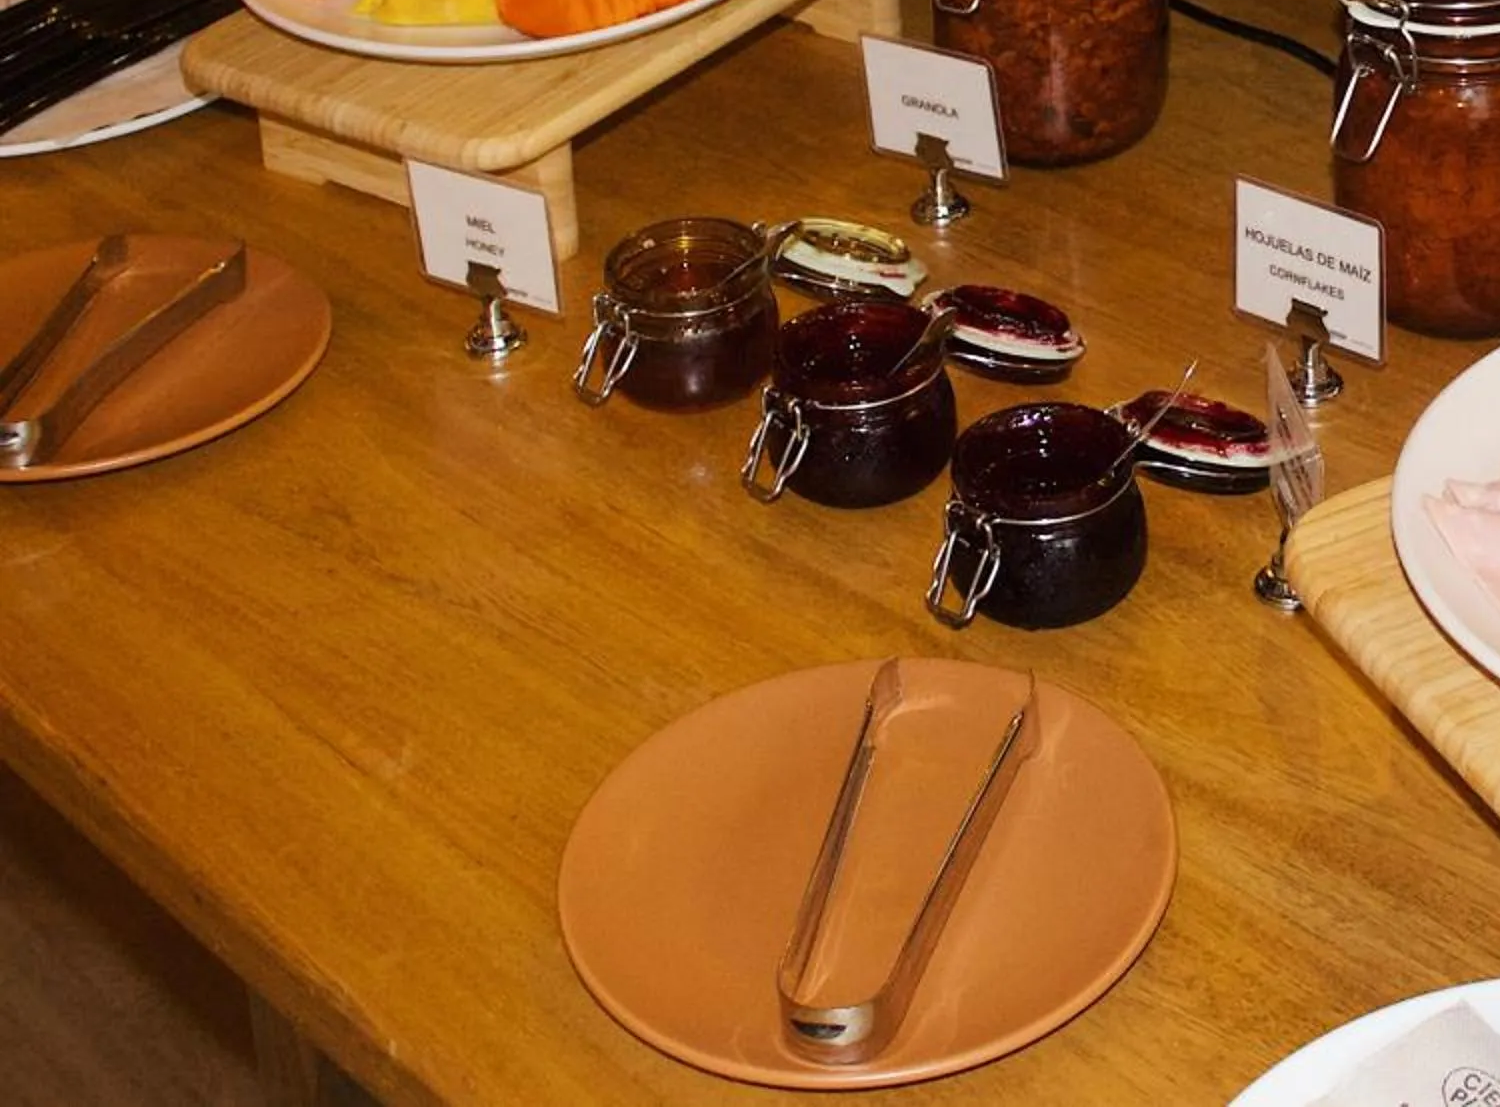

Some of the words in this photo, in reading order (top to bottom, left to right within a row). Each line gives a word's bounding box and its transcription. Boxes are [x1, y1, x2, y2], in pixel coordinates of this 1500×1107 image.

[901, 94, 960, 120] GRANOLA
[466, 214, 497, 234] MIEL
[466, 238, 505, 257] HONEY
[1245, 225, 1314, 263] HOJUELAS
[1317, 251, 1335, 270] DE
[1339, 259, 1372, 284] MAÍZ
[1269, 263, 1345, 301] CORNFLAKES
